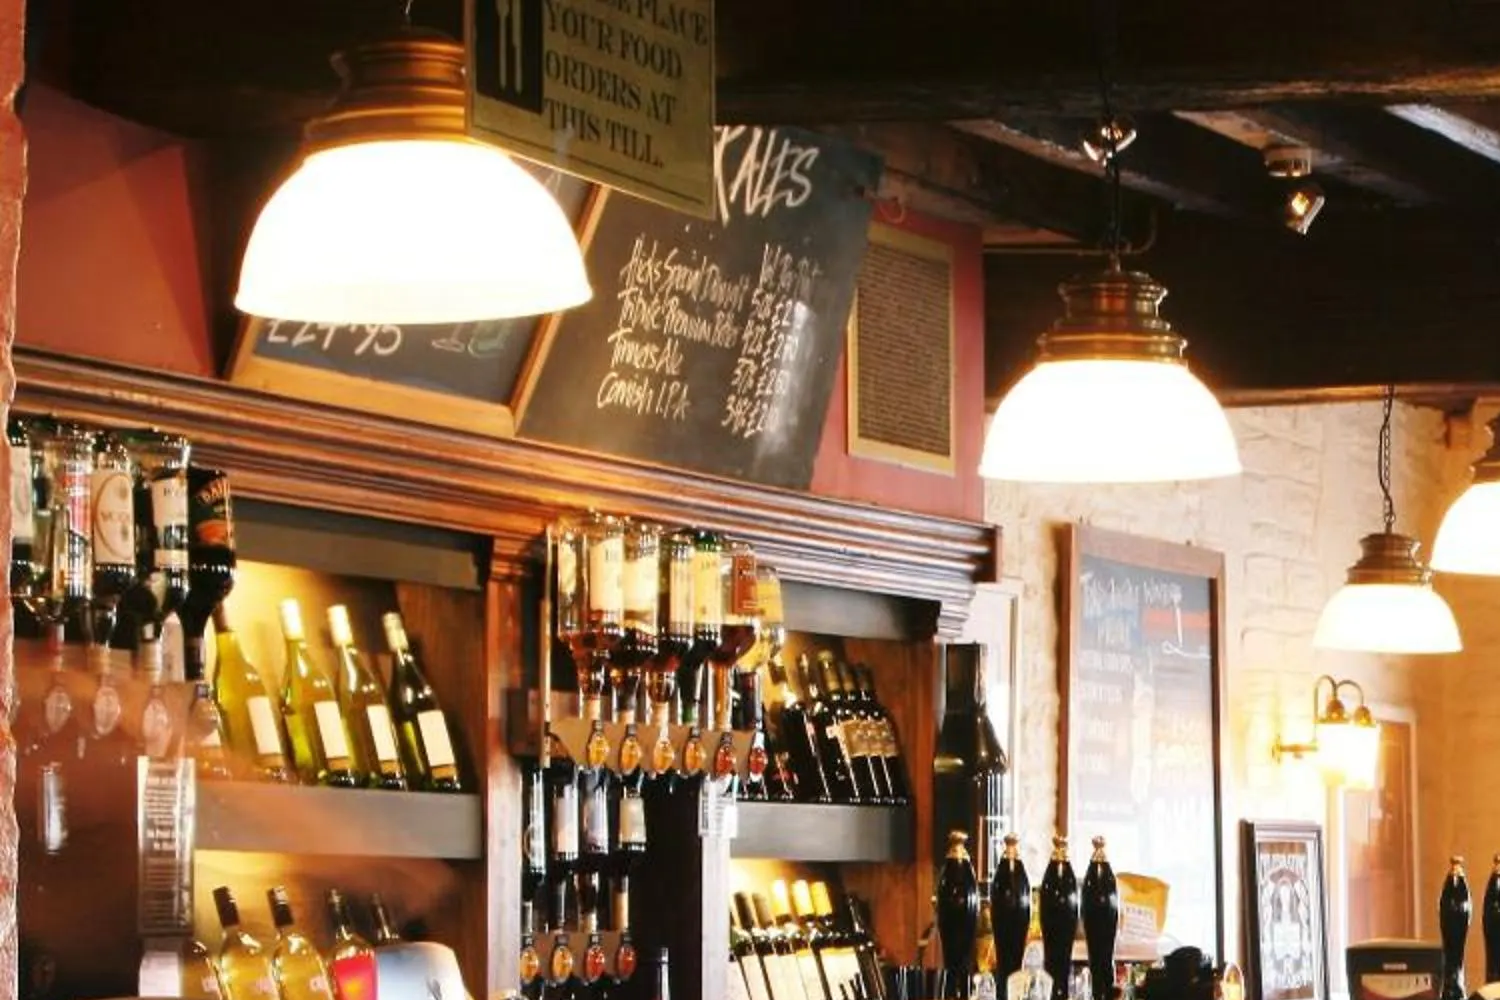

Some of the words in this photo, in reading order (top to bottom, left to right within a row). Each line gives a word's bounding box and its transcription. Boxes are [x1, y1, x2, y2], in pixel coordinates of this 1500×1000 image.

[544, 0, 613, 55] YOUR
[620, 27, 683, 79] FOOD
[636, 0, 708, 46] PLACE
[545, 50, 642, 113] ORDERS
[649, 93, 678, 126] AT
[543, 97, 601, 143] THIS
[605, 117, 665, 168] TILL.
